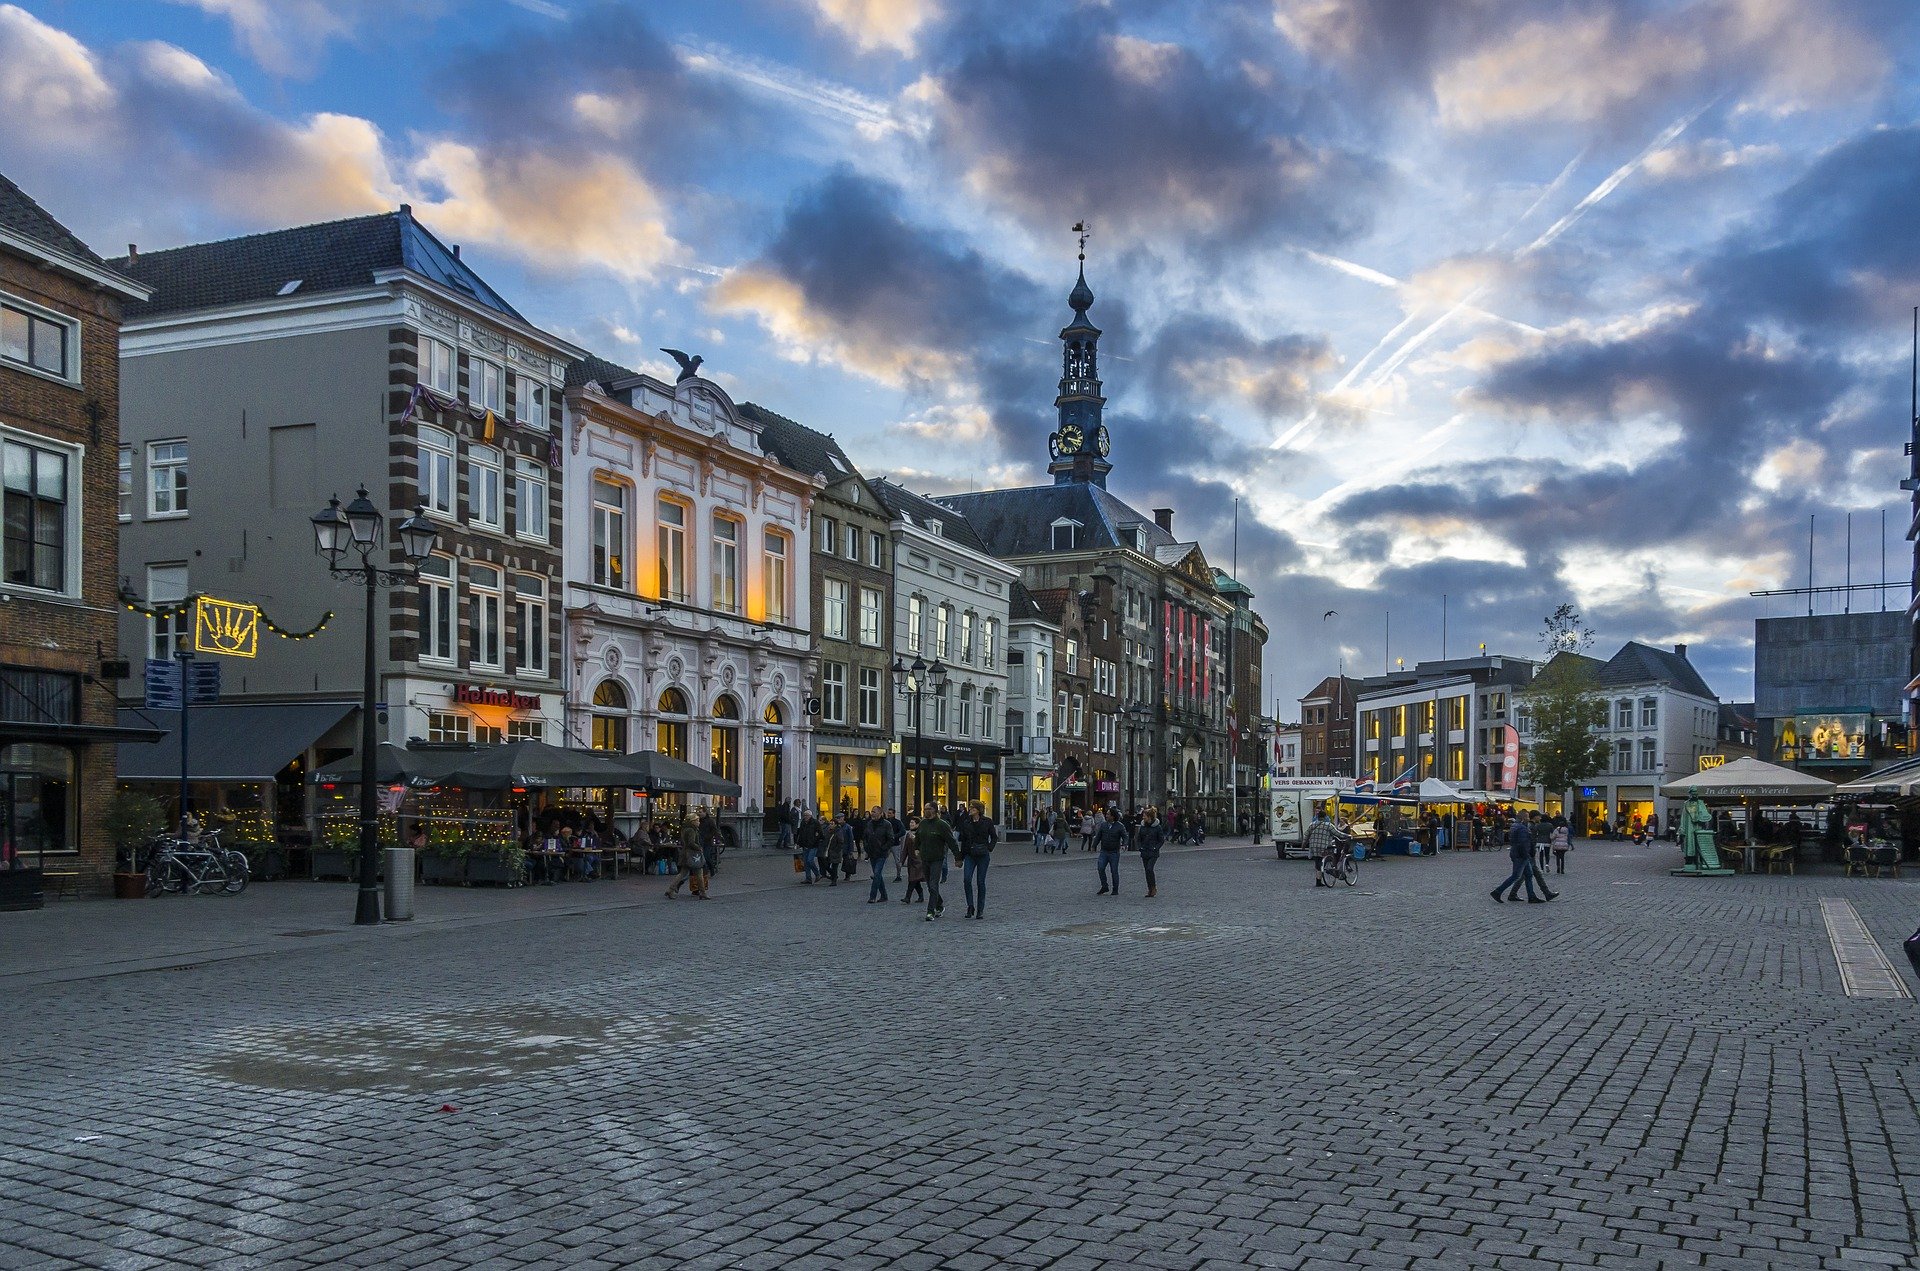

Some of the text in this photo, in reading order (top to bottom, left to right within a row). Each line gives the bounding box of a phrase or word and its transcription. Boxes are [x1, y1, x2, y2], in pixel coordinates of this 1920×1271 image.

[457, 683, 541, 710] Heineken
[808, 698, 820, 715] C
[1705, 787, 1715, 795] In
[1717, 786, 1728, 795] de
[1730, 786, 1757, 794] kleine
